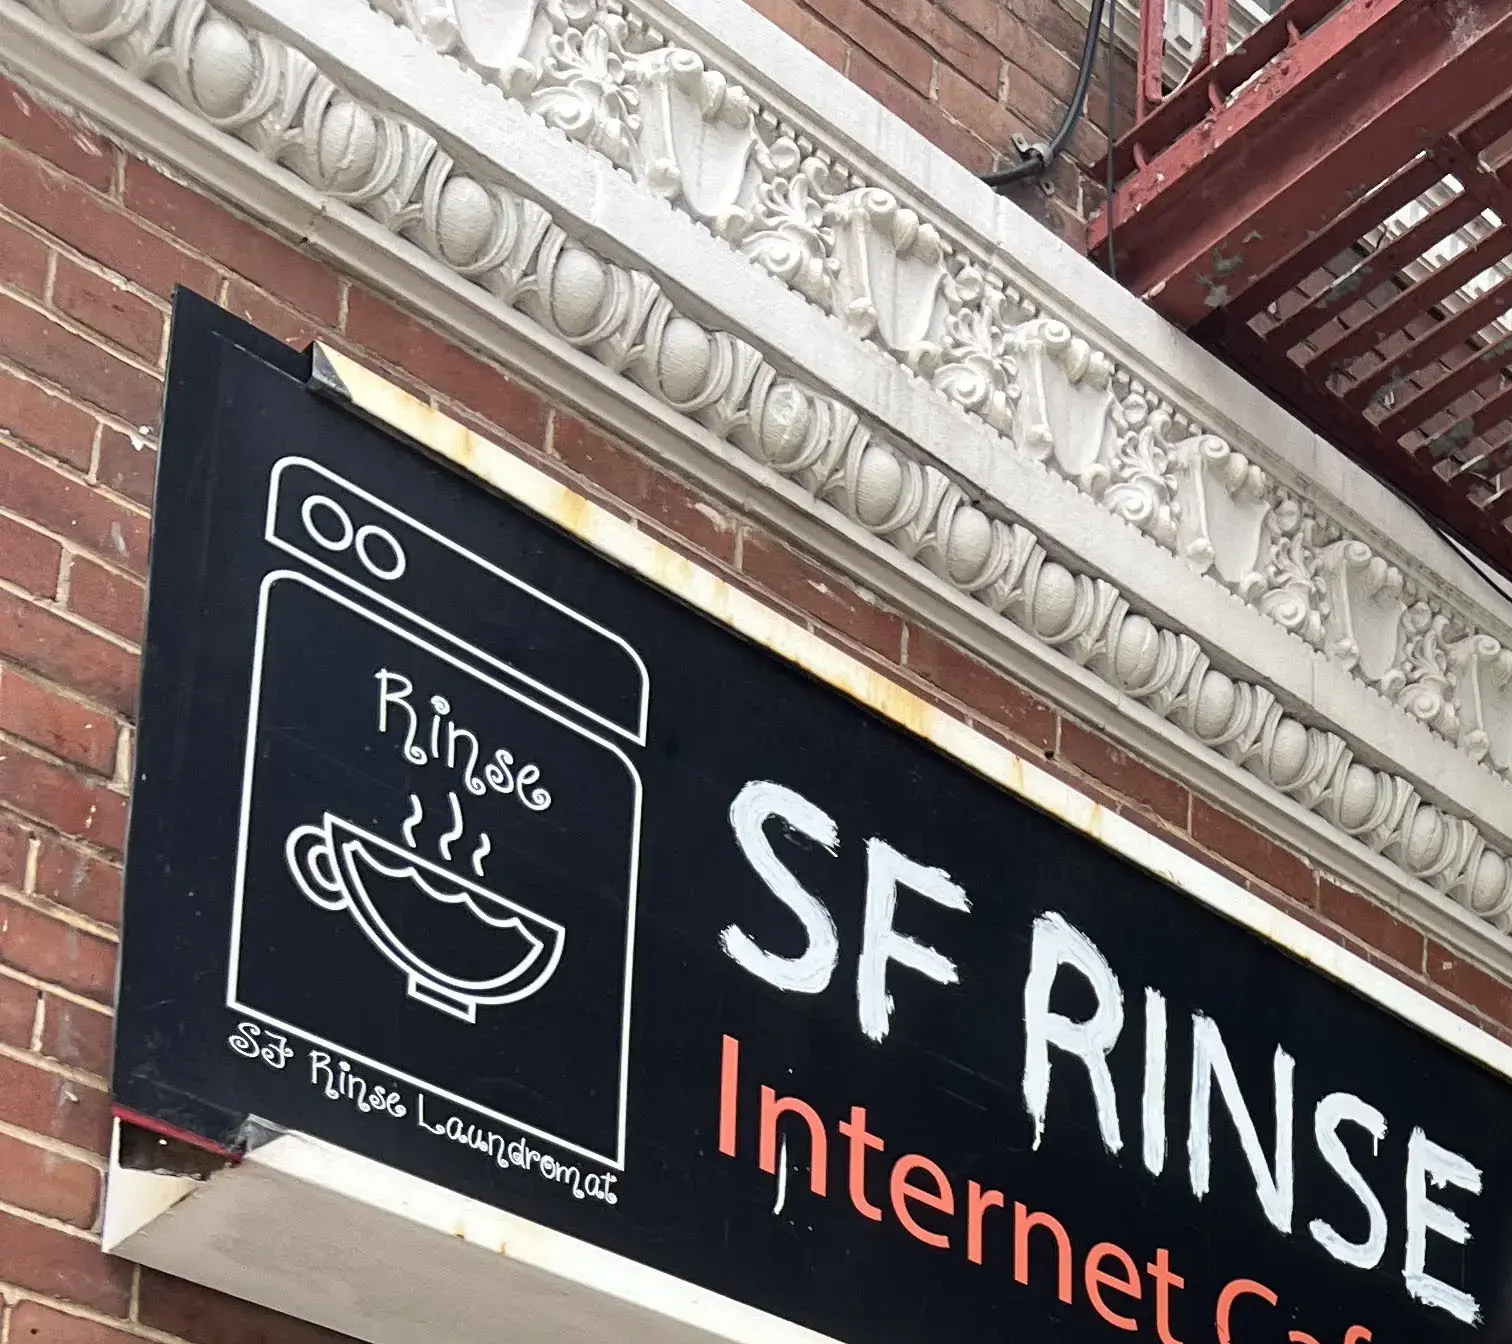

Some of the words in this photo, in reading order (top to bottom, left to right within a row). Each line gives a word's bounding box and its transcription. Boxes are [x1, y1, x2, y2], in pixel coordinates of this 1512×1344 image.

[374, 667, 553, 812] Rinse
[228, 1021, 294, 1069] SF
[309, 1049, 407, 1119] Rinse
[418, 1093, 619, 1206] Laundromat
[719, 779, 974, 1044] SF
[1022, 909, 1485, 1327] RINSE
